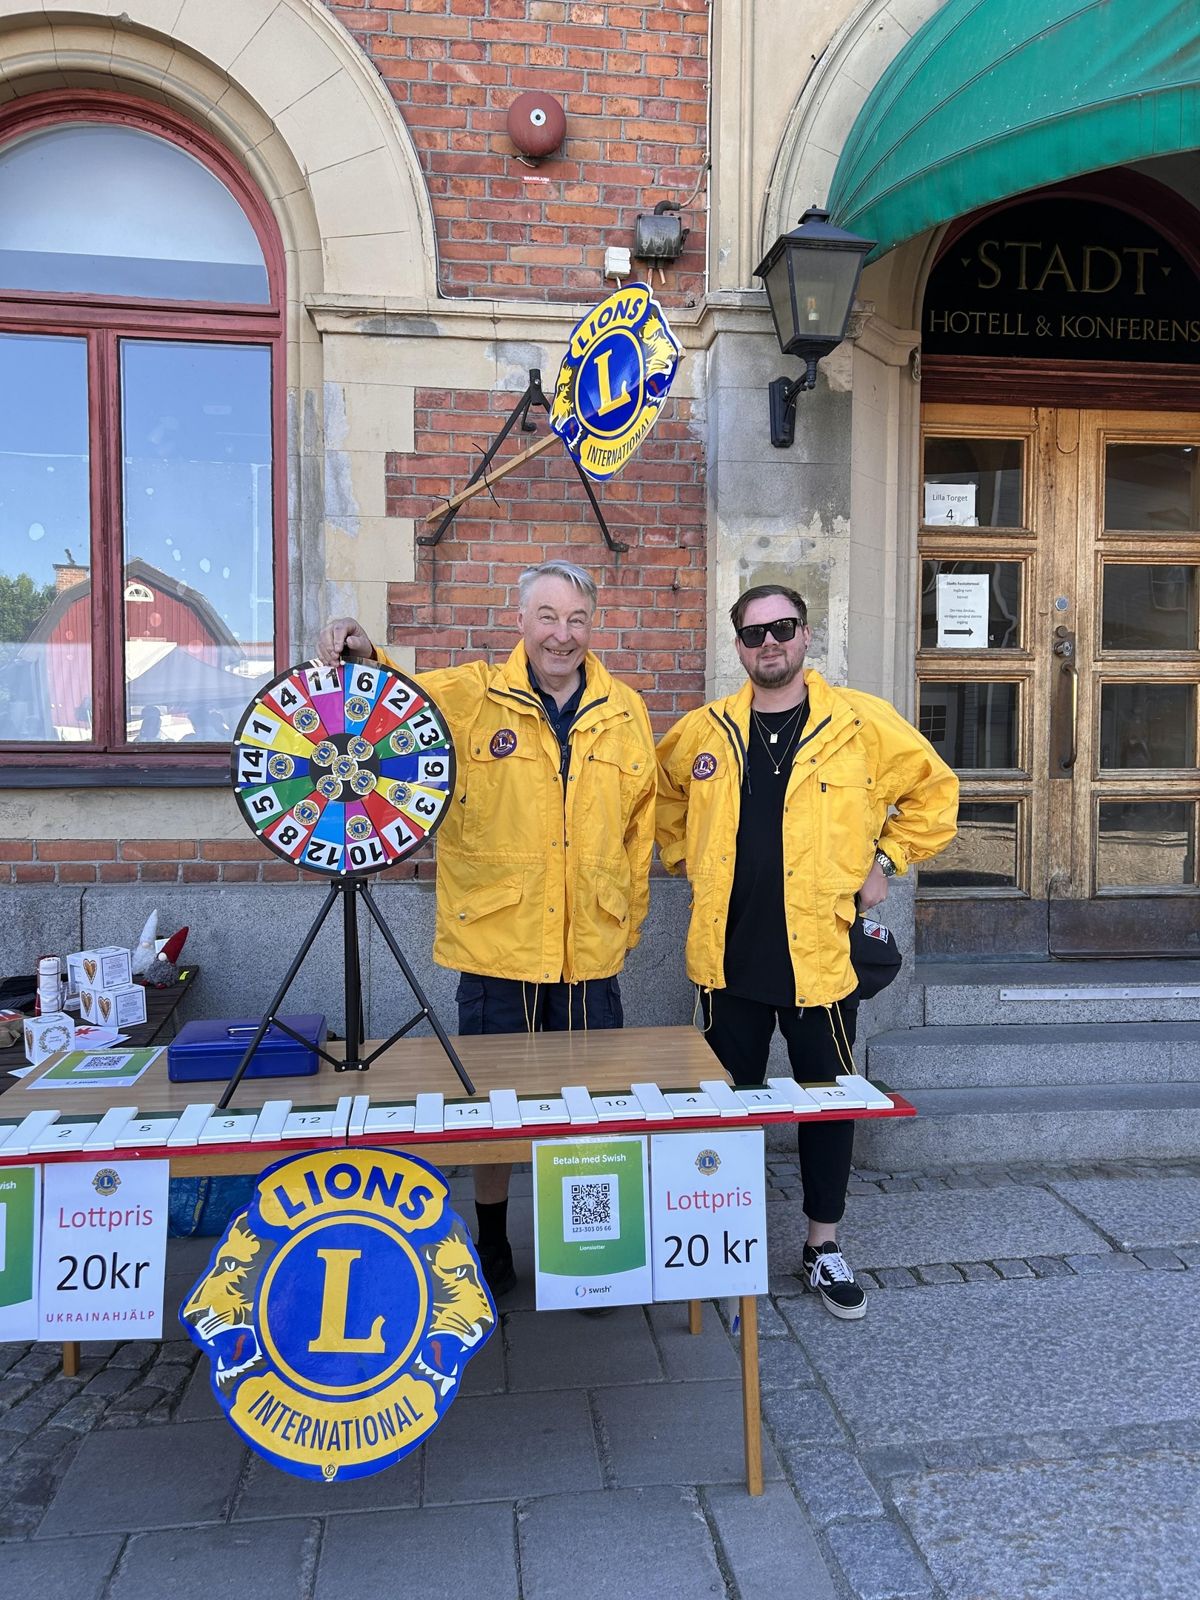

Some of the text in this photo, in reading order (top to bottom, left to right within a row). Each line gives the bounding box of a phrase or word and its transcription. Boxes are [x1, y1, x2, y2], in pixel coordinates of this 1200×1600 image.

[977, 240, 1158, 296] STADT
[577, 298, 643, 351] LIONS
[930, 310, 1200, 342] HOTELL & KONFERENS
[594, 349, 632, 416] L
[946, 509, 954, 520] 4
[308, 668, 340, 692] 11
[278, 687, 298, 708] 4
[388, 688, 411, 710] 2
[252, 719, 272, 734] 1
[412, 714, 440, 746] 13
[241, 751, 264, 782] 14
[253, 796, 275, 814] 5
[415, 796, 436, 815] 3
[278, 826, 299, 845] 8
[394, 827, 412, 847] 7
[307, 840, 340, 866] 12
[350, 842, 383, 866] 10
[58, 1129, 72, 1138] 2
[553, 1154, 626, 1164] Betala med Swish
[272, 1163, 434, 1221] LIONS
[666, 1187, 752, 1213] Lottpris
[58, 1204, 153, 1232] Lottpris
[664, 1231, 758, 1268] 20 kr
[56, 1252, 150, 1291] 20kr
[308, 1248, 386, 1354] L
[46, 1309, 155, 1323] UKRAINAHJÄLP
[247, 1389, 424, 1451] INTERNATIONAL
